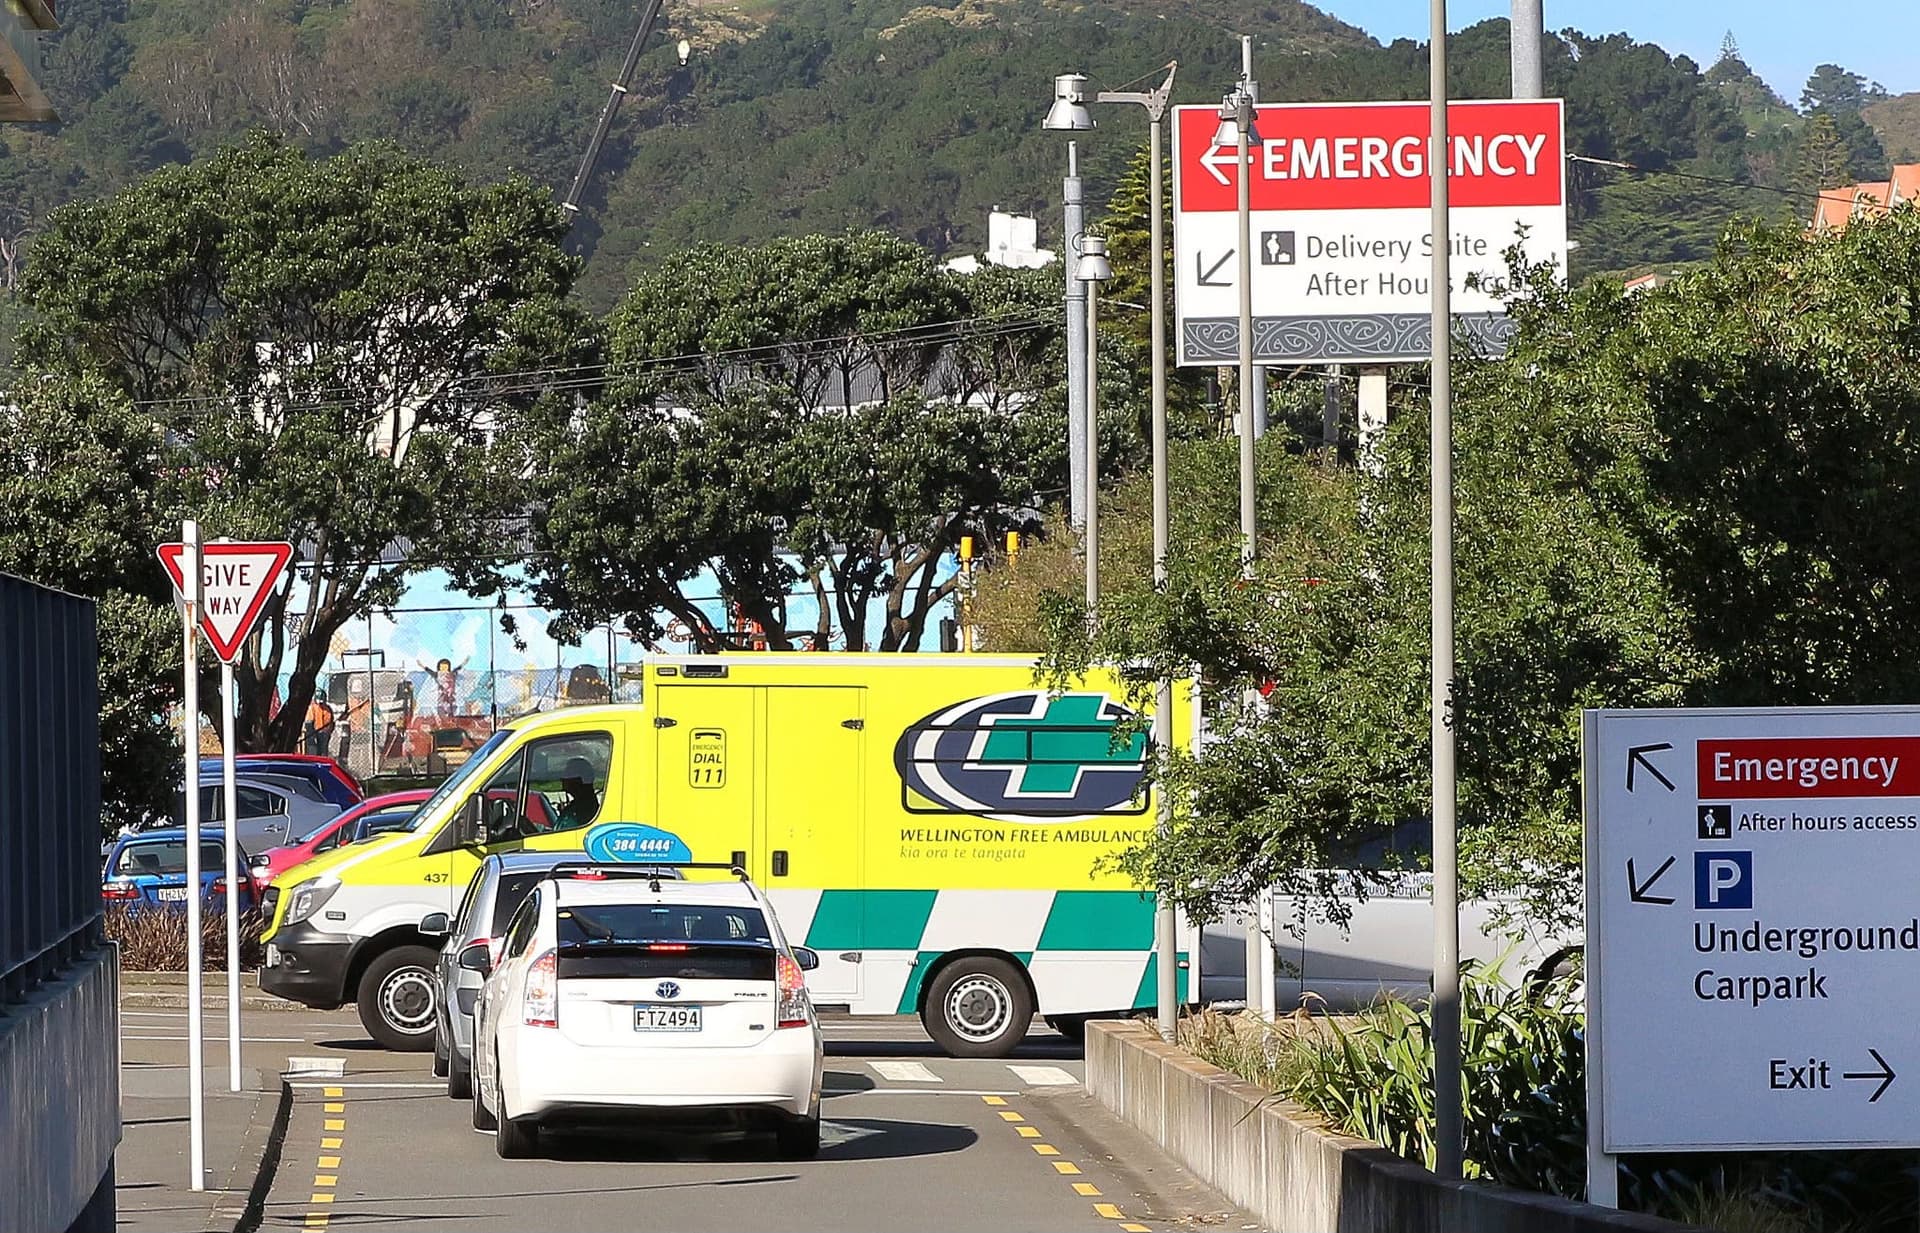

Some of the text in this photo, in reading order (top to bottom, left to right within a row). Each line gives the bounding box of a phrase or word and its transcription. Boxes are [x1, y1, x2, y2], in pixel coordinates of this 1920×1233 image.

[1306, 233, 1487, 263] Delivery Site
[1306, 272, 1369, 296] After
[1379, 272, 1453, 296] Hous
[203, 564, 251, 587] GIVE
[210, 597, 241, 615] WAY
[693, 753, 722, 764] DIAL
[1714, 751, 1899, 788] Emergency
[1738, 812, 1917, 831] After hours access
[612, 839, 636, 852] 384
[900, 829, 1150, 843] WELLINGTON FREE AMBULANCE
[900, 845, 1026, 862] kia ora te tangata
[423, 873, 448, 883] 437
[1709, 859, 1742, 903] P
[1694, 918, 1919, 959] Underground
[1694, 967, 1828, 1007] Carpark
[636, 1010, 698, 1026] FTZ494
[1770, 1058, 1831, 1089] Exit
